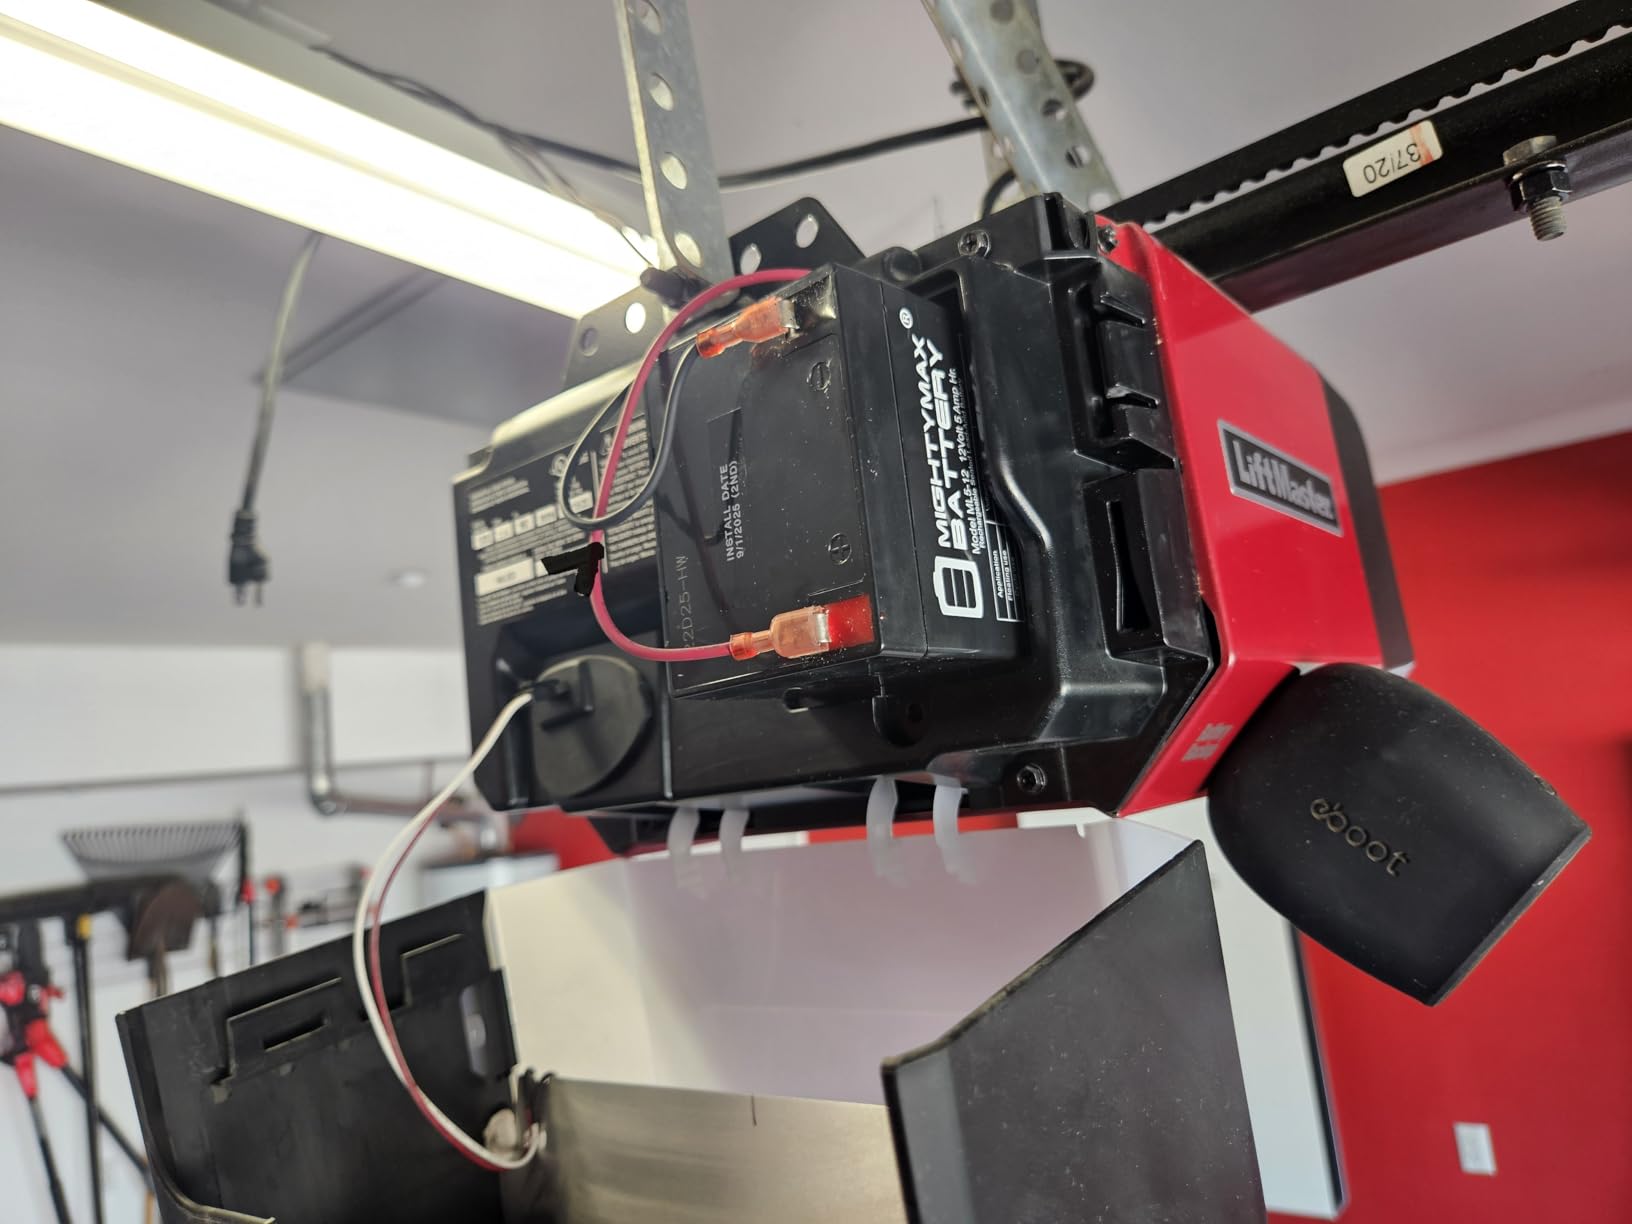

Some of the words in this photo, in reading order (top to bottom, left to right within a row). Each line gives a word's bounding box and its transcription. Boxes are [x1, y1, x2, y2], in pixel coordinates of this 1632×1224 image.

[948, 368, 958, 385] Hr.
[951, 386, 963, 415] Amp
[953, 415, 963, 425] 5
[911, 333, 951, 548] MIGHTYMAX
[926, 338, 969, 551] BATTERY
[955, 425, 968, 462] 12Volt
[719, 463, 730, 502] DATE
[728, 460, 740, 498] (2ND)
[961, 469, 977, 517] ML5-12
[1232, 440, 1335, 520] LiftMaster
[722, 505, 735, 562] INSTALL
[731, 503, 745, 559] 9/1/2025
[970, 516, 982, 554] Model
[971, 489, 986, 549] Rechargeable
[993, 550, 1004, 598] Application
[1002, 550, 1010, 565] use
[1003, 567, 1013, 601] Floating
